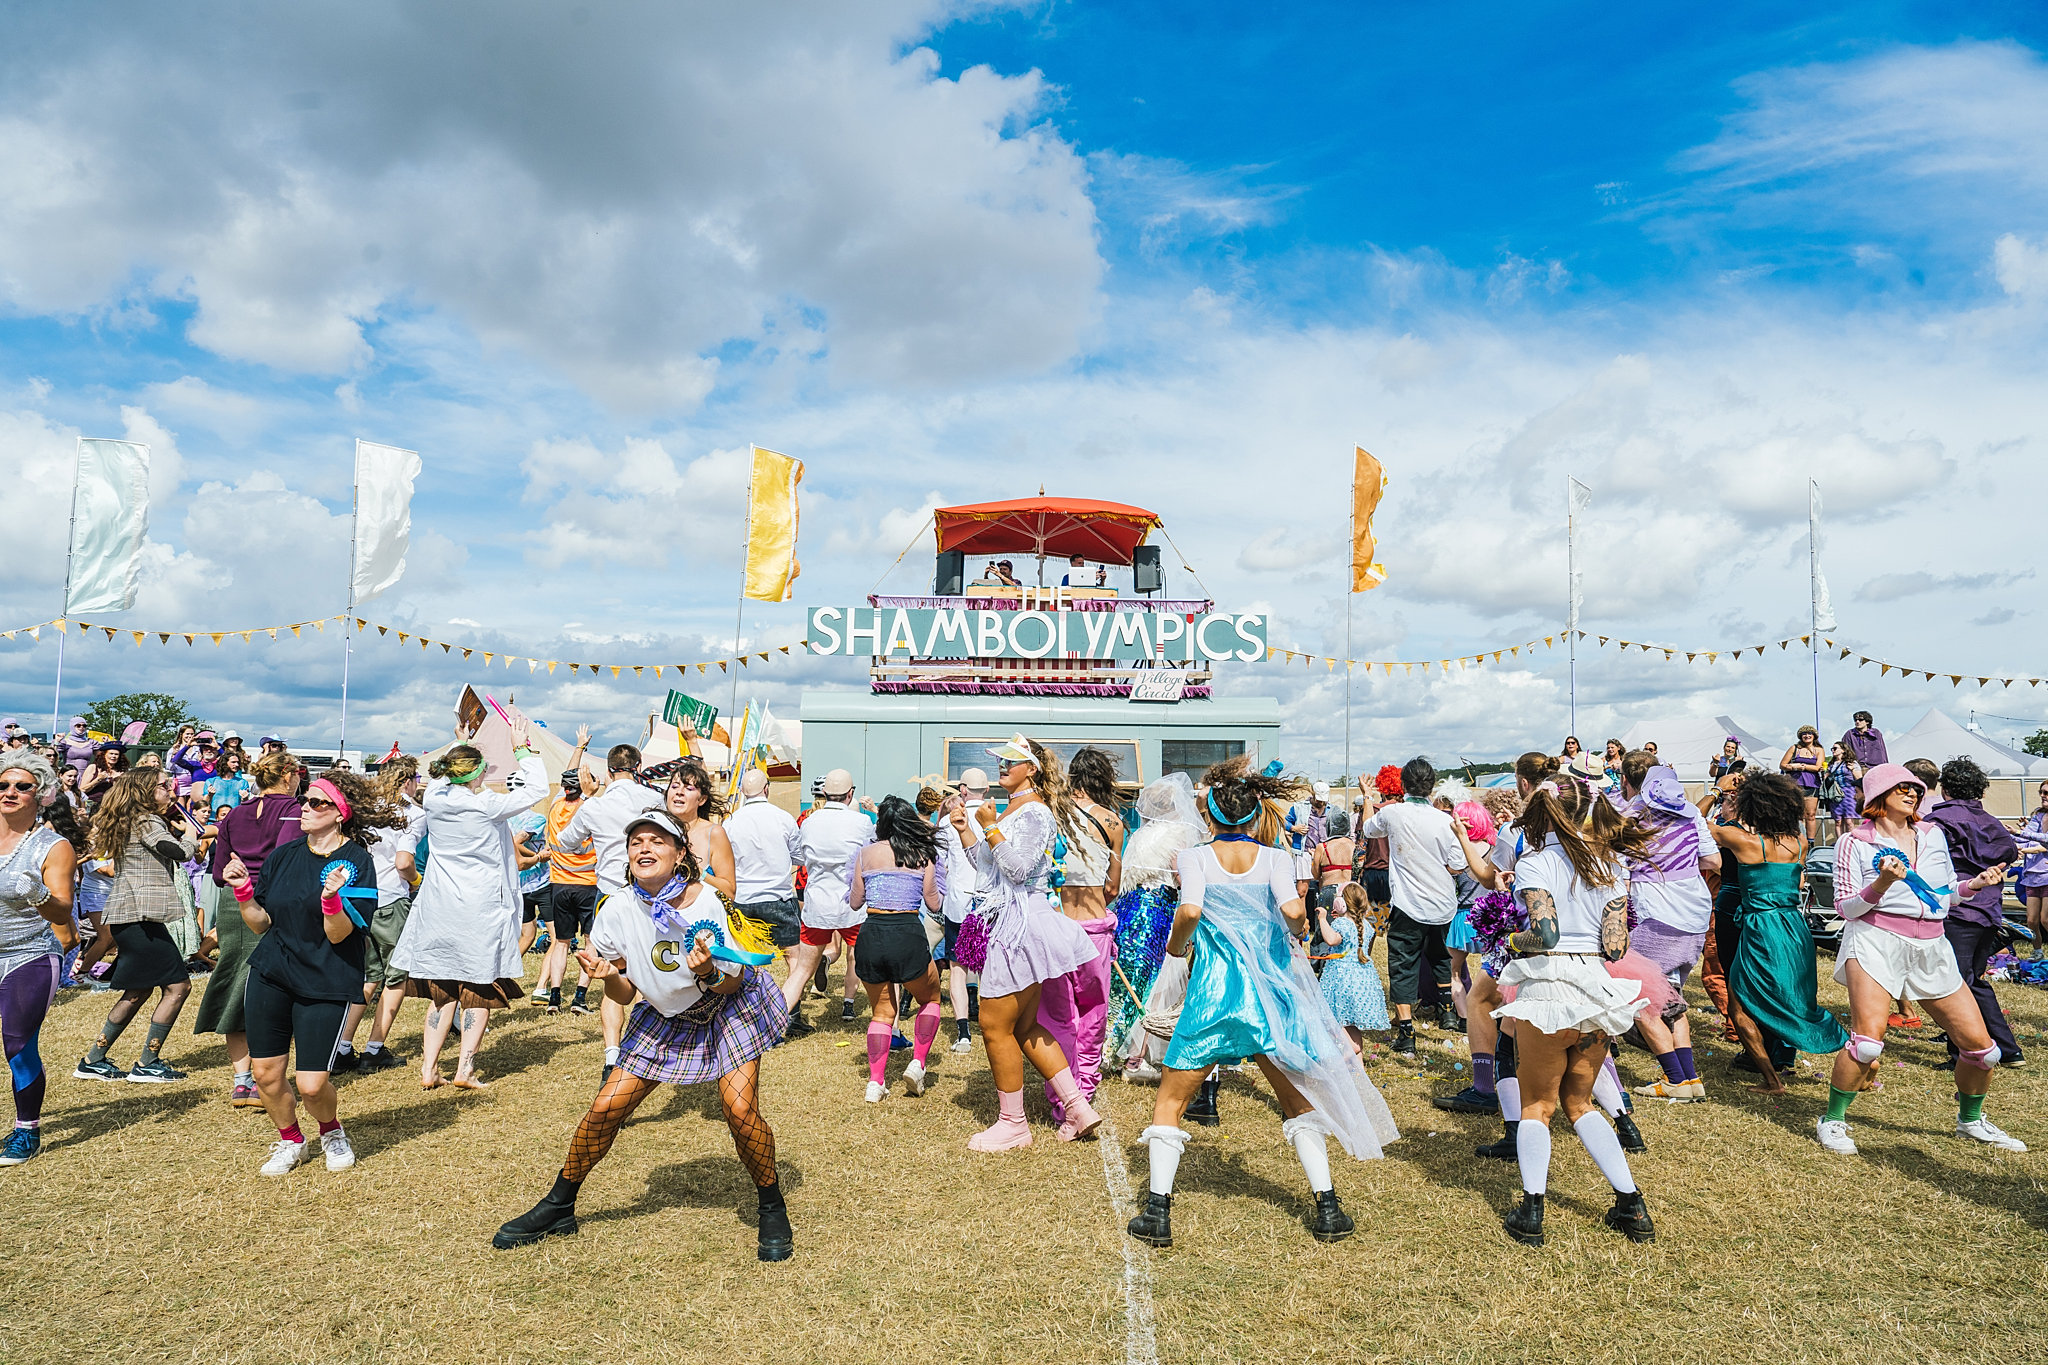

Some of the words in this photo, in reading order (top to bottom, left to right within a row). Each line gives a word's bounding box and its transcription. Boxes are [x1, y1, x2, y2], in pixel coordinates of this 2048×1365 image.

[1017, 585, 1072, 611] THE
[810, 607, 1265, 662] SHAMBOLYMPICS
[1134, 684, 1177, 698] Circus
[1140, 671, 1182, 691] Village
[651, 940, 680, 972] C
